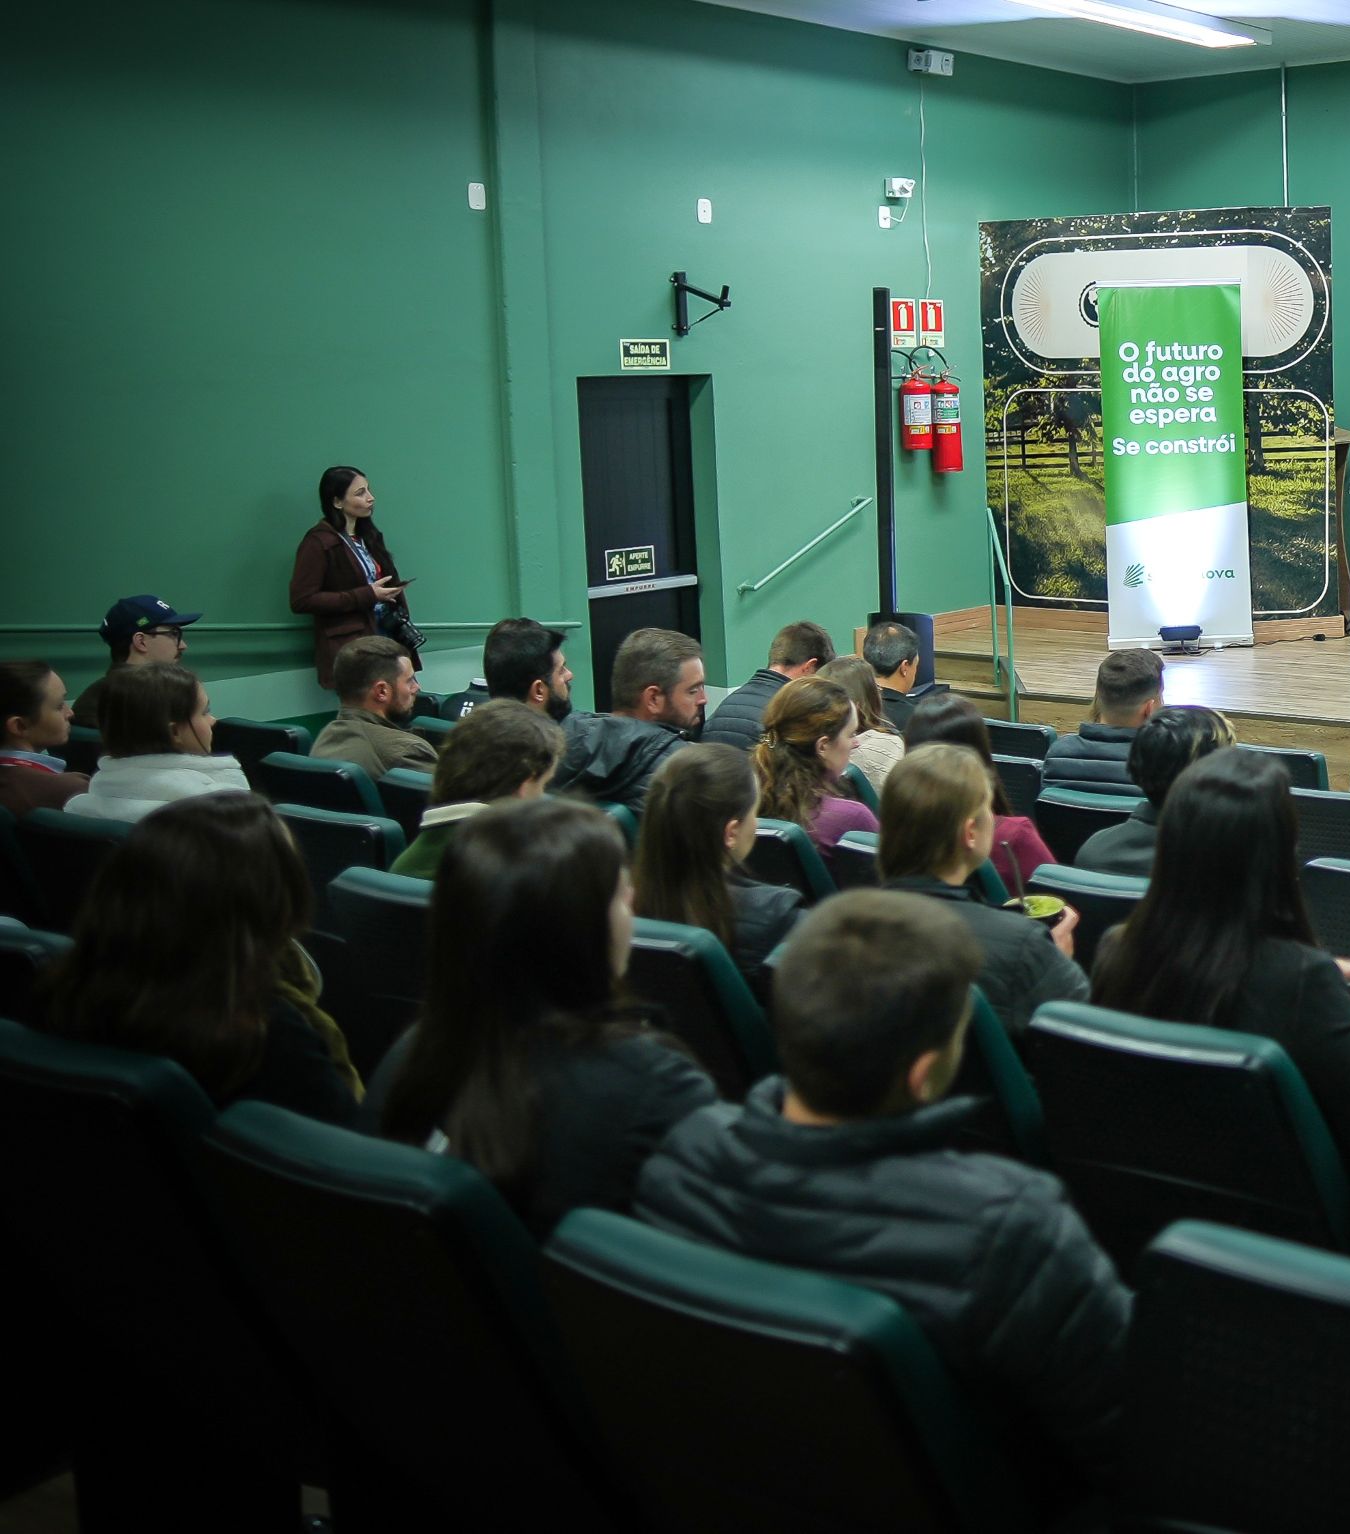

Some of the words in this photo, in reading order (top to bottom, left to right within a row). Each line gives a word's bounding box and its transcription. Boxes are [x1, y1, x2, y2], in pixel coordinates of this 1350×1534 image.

[630, 343, 650, 354] SAÍDA
[651, 345, 660, 354] DE
[1119, 341, 1139, 362] O
[1145, 340, 1223, 366] futuro
[624, 355, 667, 366] EMERGÊNCIA
[1122, 362, 1156, 383] do
[1161, 365, 1221, 386] agro
[1130, 382, 1180, 403] não
[1185, 386, 1214, 402] se
[1129, 406, 1217, 429] espera
[1112, 437, 1141, 456] Se
[1145, 434, 1236, 455] constrói
